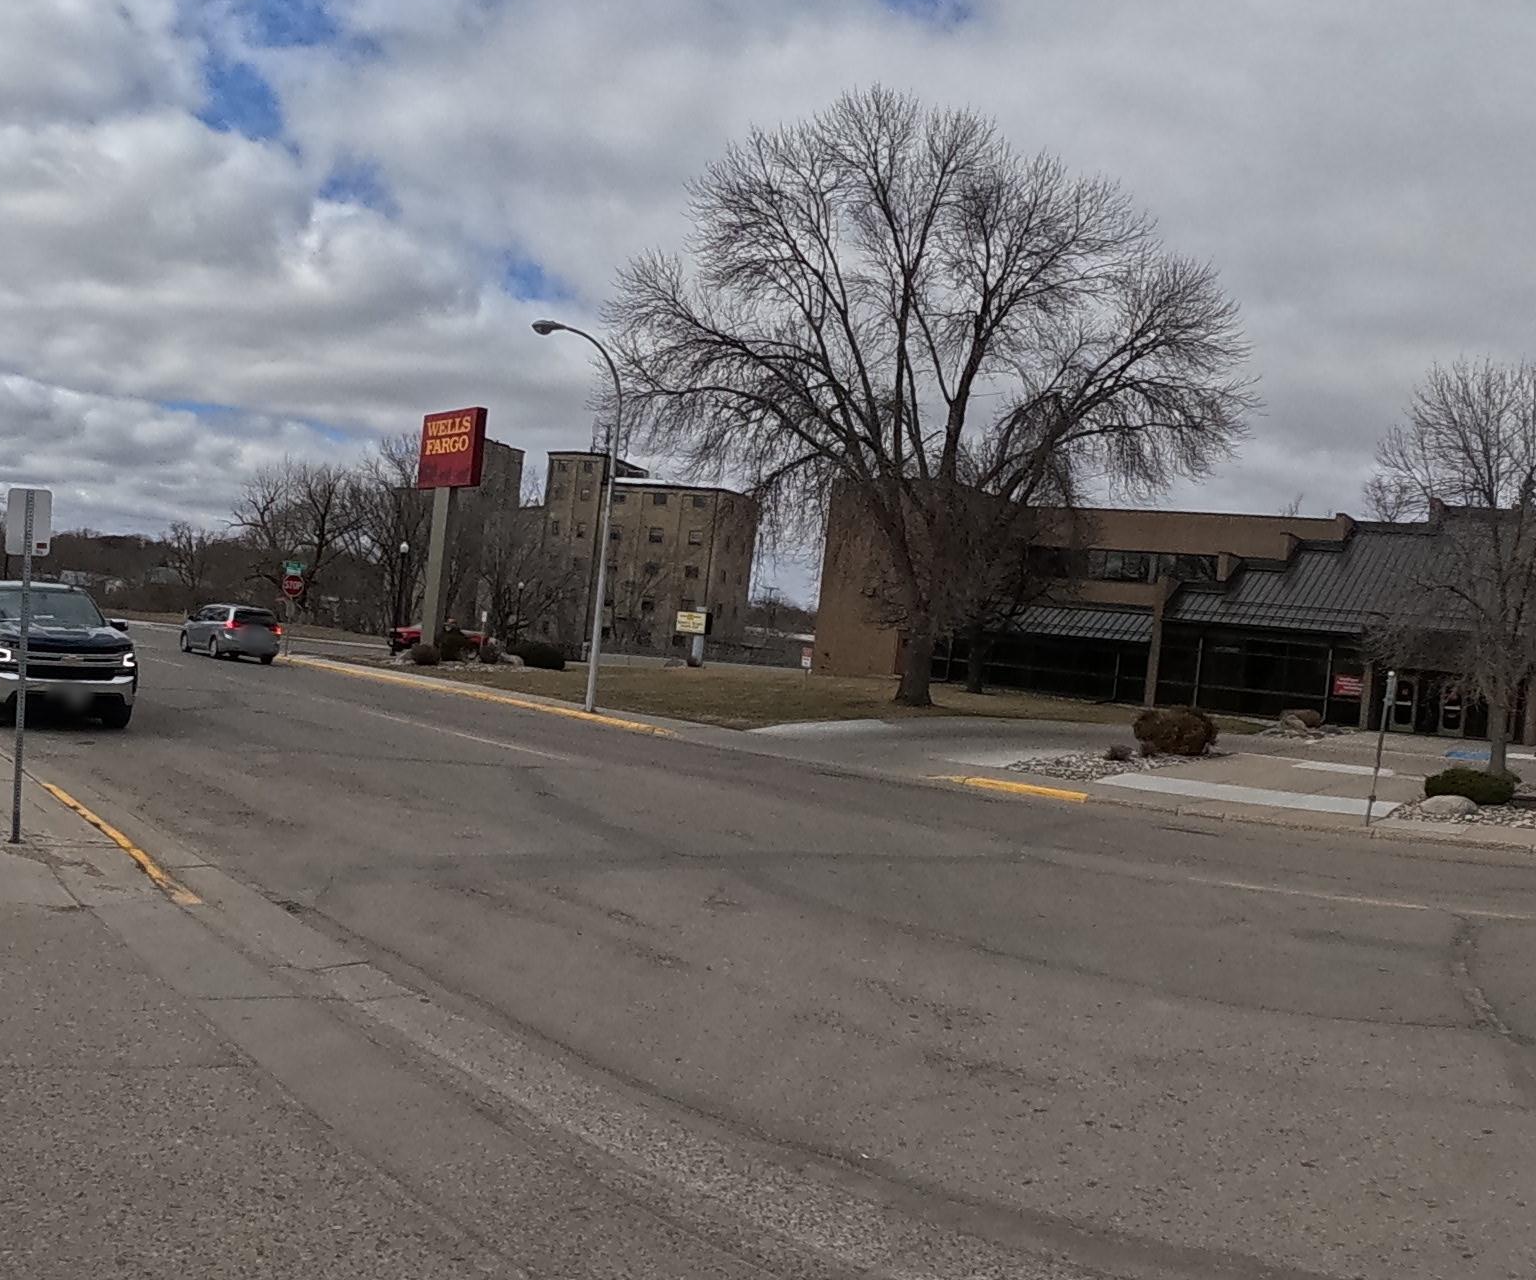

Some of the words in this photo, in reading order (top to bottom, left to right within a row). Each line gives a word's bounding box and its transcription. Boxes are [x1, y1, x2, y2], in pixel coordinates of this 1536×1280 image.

[427, 416, 472, 437] WELLS
[425, 435, 470, 455] FARGO
[284, 580, 302, 590] STOP
